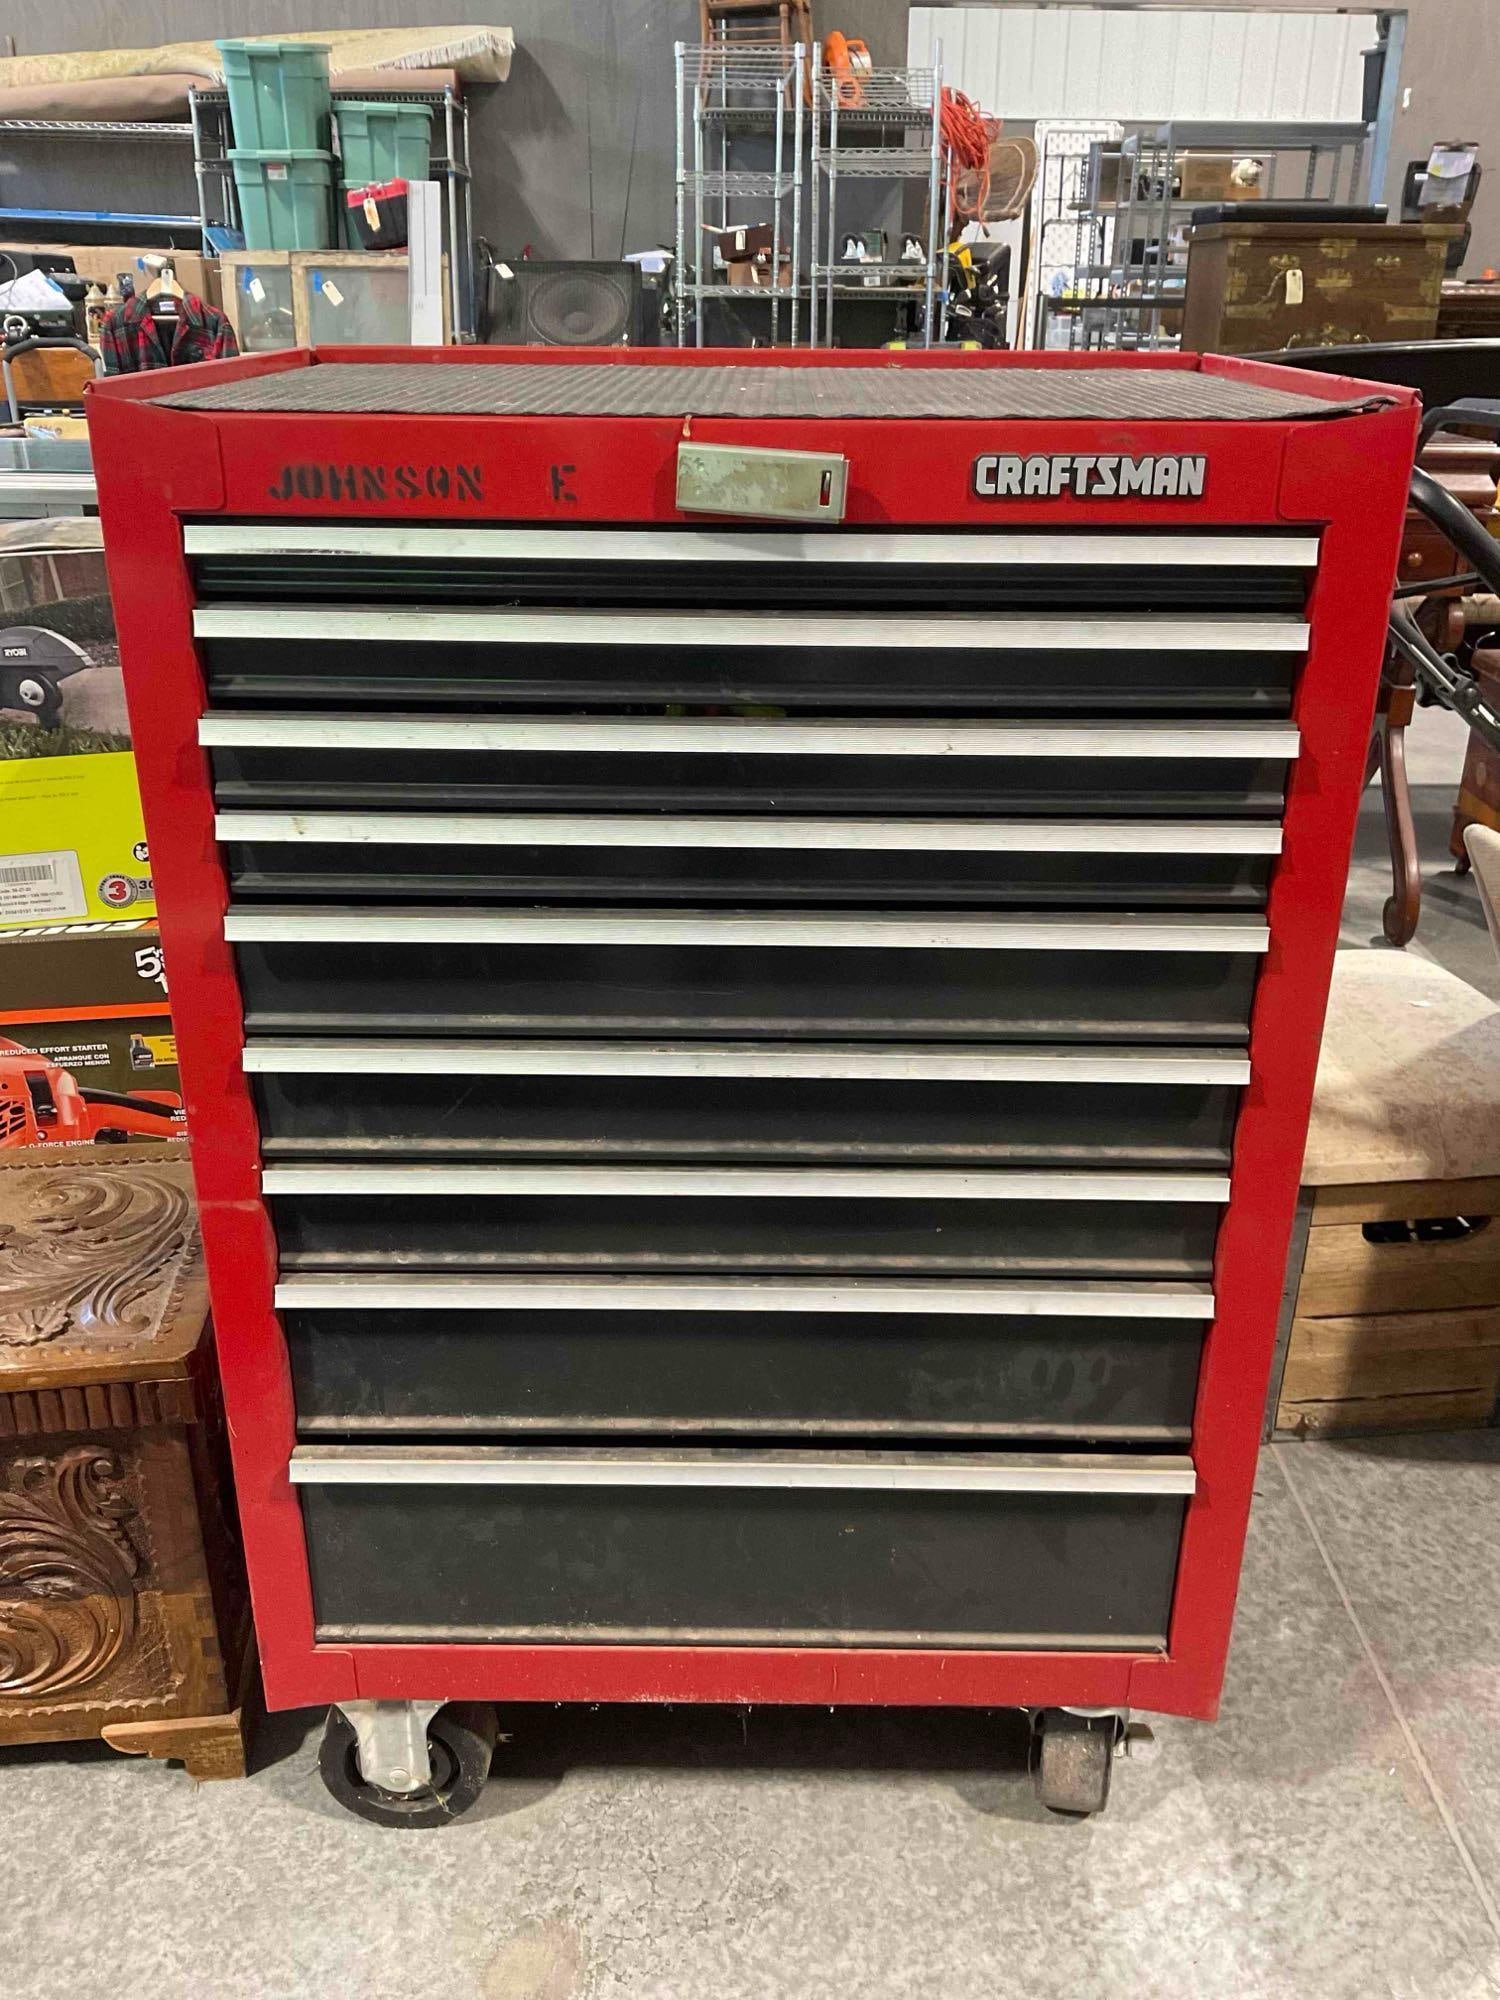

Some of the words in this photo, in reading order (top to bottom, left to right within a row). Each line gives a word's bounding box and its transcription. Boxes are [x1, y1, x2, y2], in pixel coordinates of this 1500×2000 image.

[268, 464, 484, 501] JOHNSON
[550, 464, 577, 501] E
[975, 456, 1206, 496] CRAFTSMAN
[108, 881, 127, 901] 3
[134, 946, 162, 978] 5
[0, 1048, 38, 1056] REDUCED
[40, 1045, 70, 1054] EFFORT
[72, 1043, 108, 1052] STARTER
[65, 1138, 96, 1147] ENGINE
